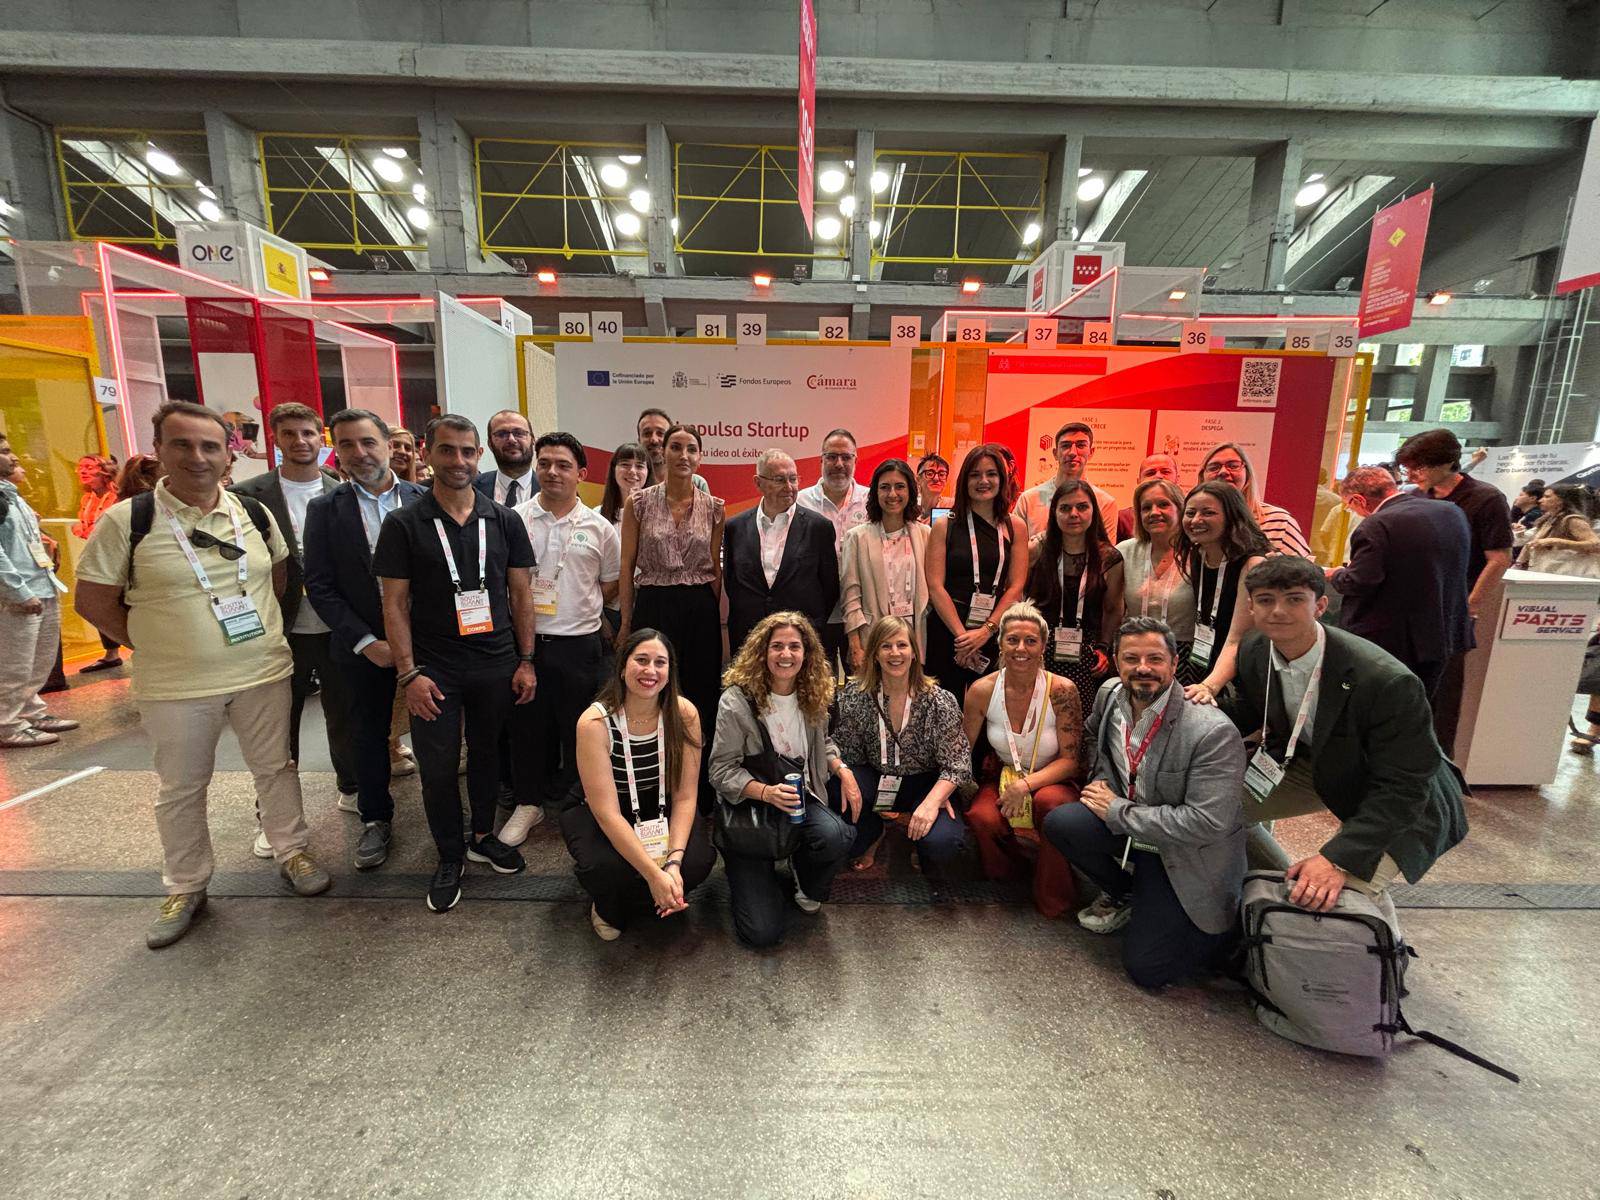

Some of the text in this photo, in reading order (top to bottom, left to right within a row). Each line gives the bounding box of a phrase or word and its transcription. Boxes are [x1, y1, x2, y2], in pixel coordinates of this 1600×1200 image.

[565, 322, 585, 335] 80
[598, 321, 618, 334] 40
[704, 324, 720, 337] 81
[742, 323, 762, 336] 39
[825, 326, 844, 339] 82
[896, 325, 916, 338] 38
[962, 328, 981, 341] 83
[1034, 328, 1052, 341] 37
[1089, 331, 1108, 344] 84
[1187, 332, 1206, 345] 36
[1291, 336, 1310, 349] 85
[1334, 335, 1353, 348] 35
[739, 377, 792, 388] Fondos Europeos
[806, 374, 857, 389] Cámara
[100, 385, 117, 397] 79
[747, 421, 810, 441] Startup
[710, 447, 729, 458] idea
[731, 448, 741, 458] al
[1518, 605, 1557, 613] VISUAL
[1512, 614, 1587, 626] PARTS
[1536, 626, 1585, 634] SERVICE
